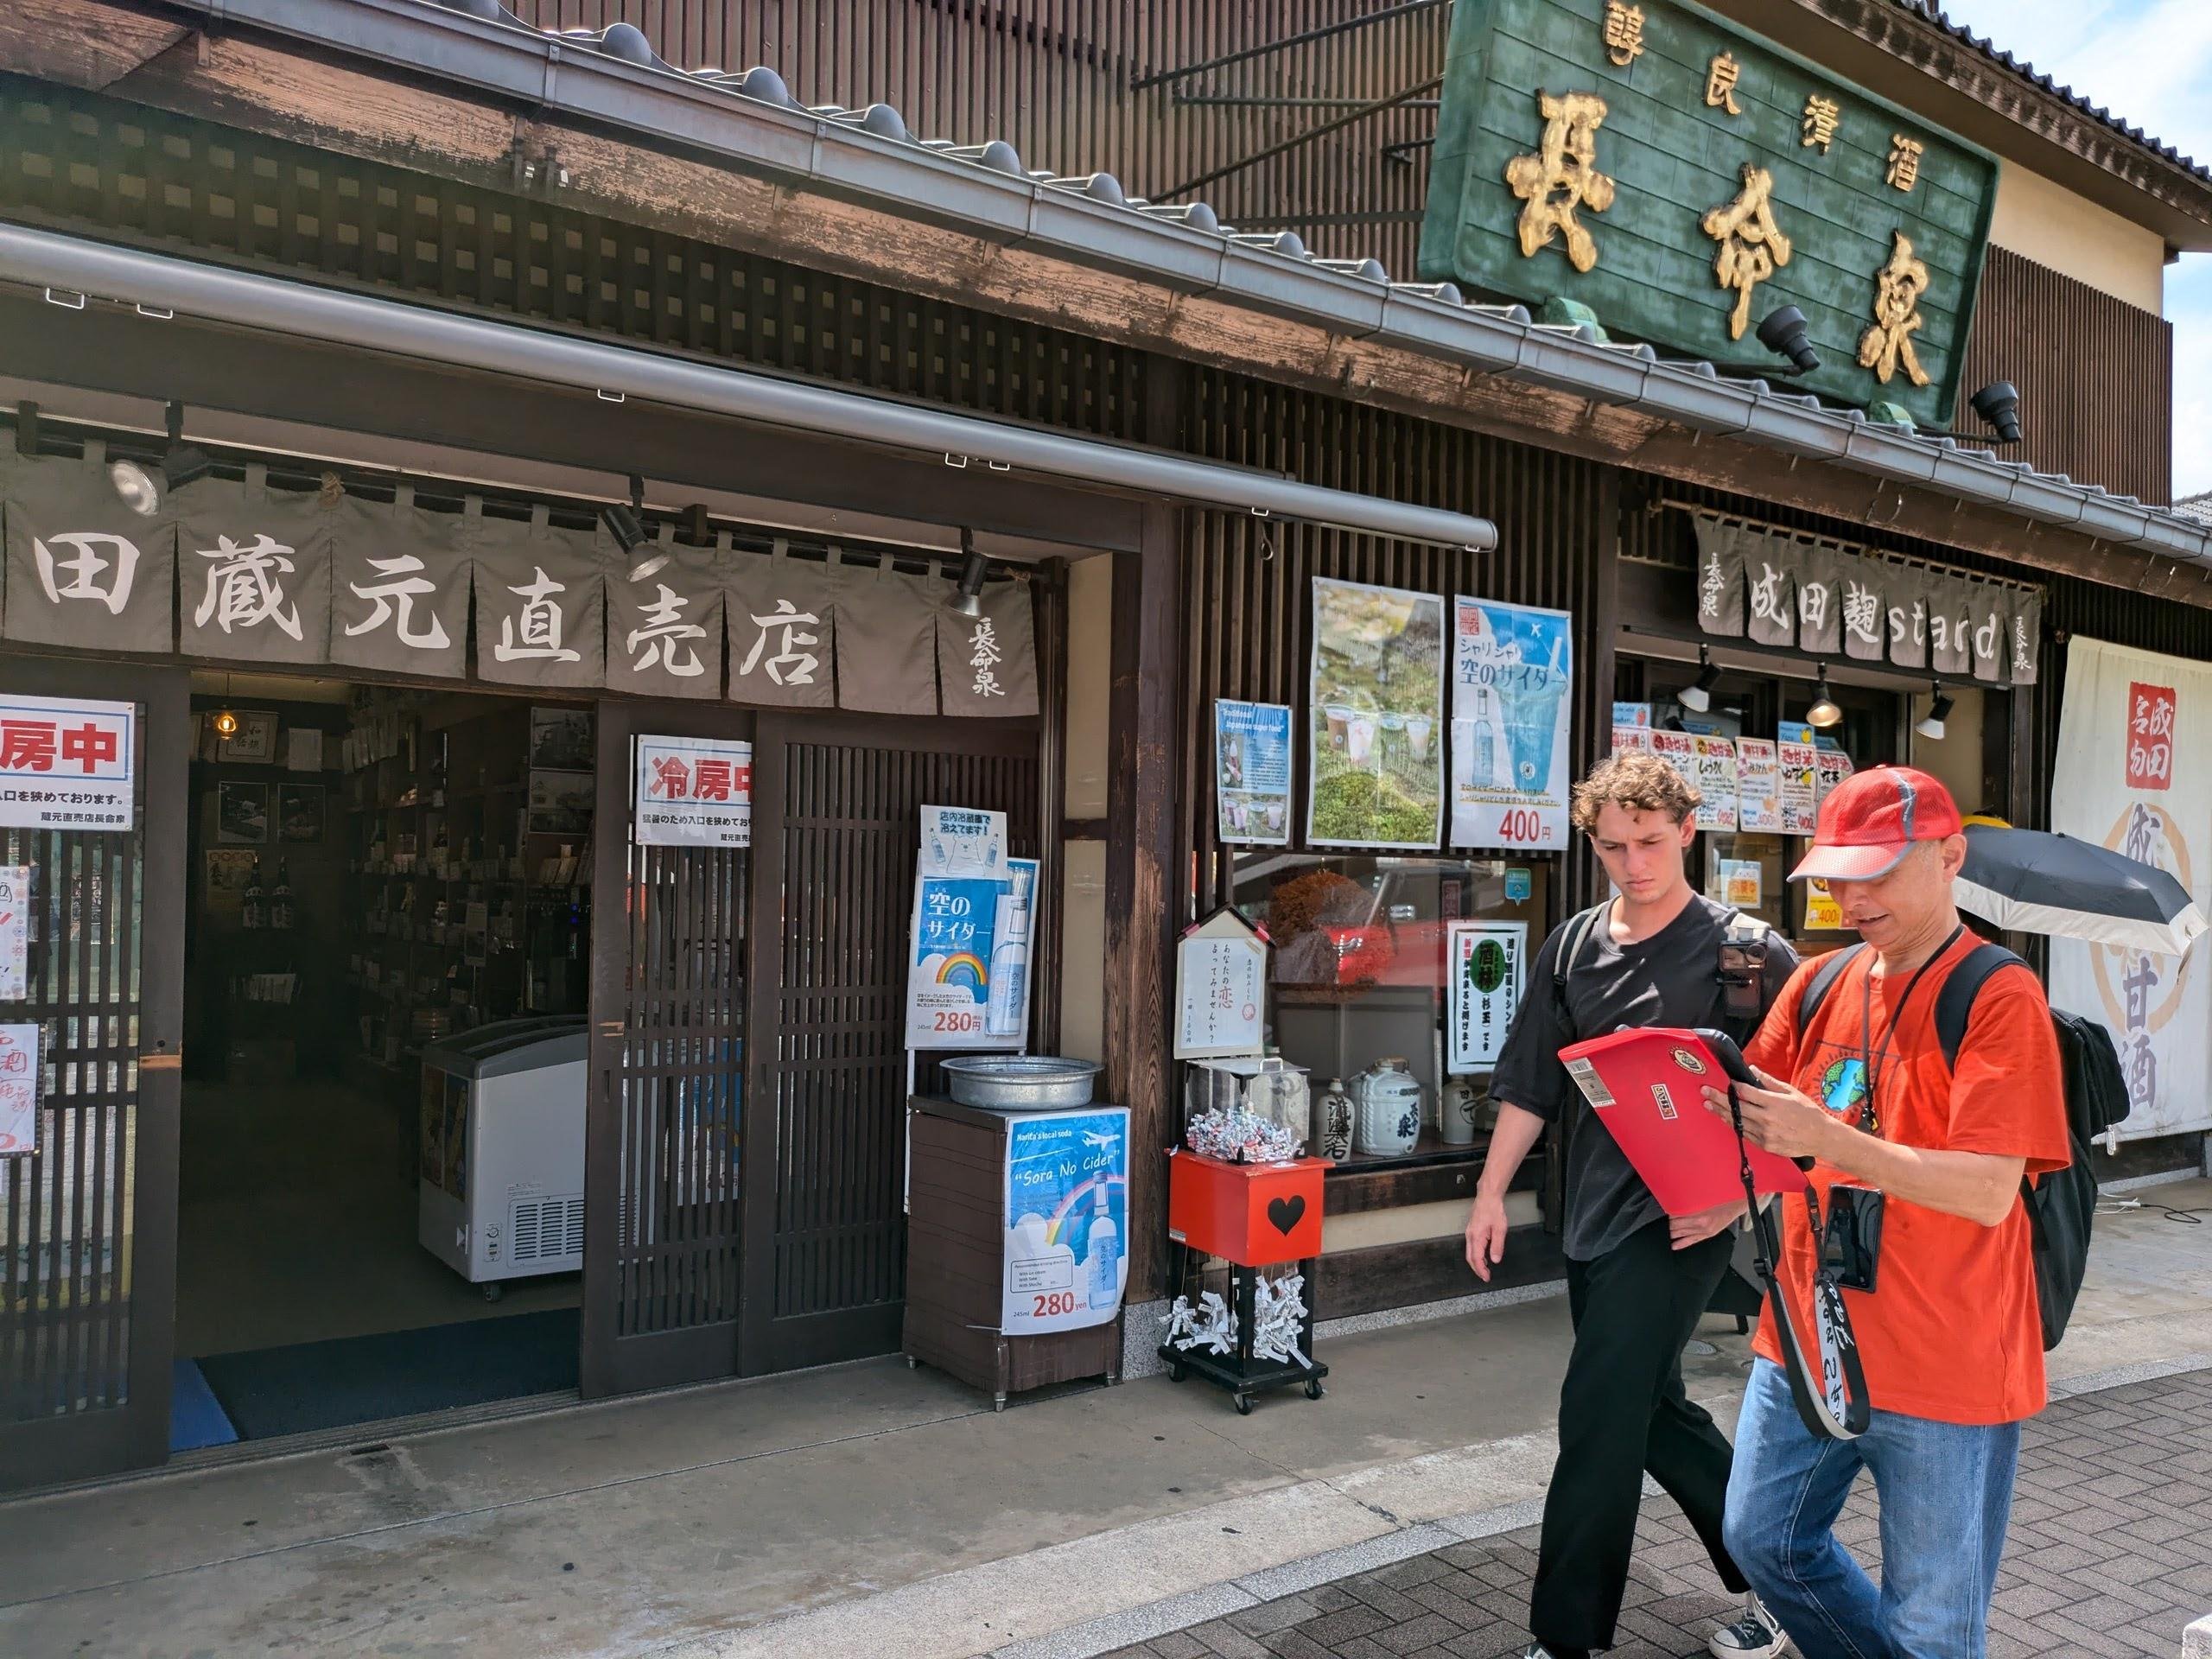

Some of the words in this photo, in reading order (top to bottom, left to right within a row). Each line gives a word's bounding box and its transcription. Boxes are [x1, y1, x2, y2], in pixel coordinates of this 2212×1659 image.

[33, 531, 821, 687] 田蔵元直売店
[968, 615, 1006, 698] 長命泉
[1459, 658, 1567, 691] 空のサイダー
[939, 811, 992, 825] 店内冷蔵庫で
[928, 893, 971, 917] 空の
[928, 920, 991, 941] サイダー
[1042, 1130, 1058, 1140] local
[1058, 1129, 1072, 1138] soda
[1059, 1161, 1077, 1177] No
[1033, 1291, 1075, 1318] 280
[1075, 1301, 1087, 1311] yen
